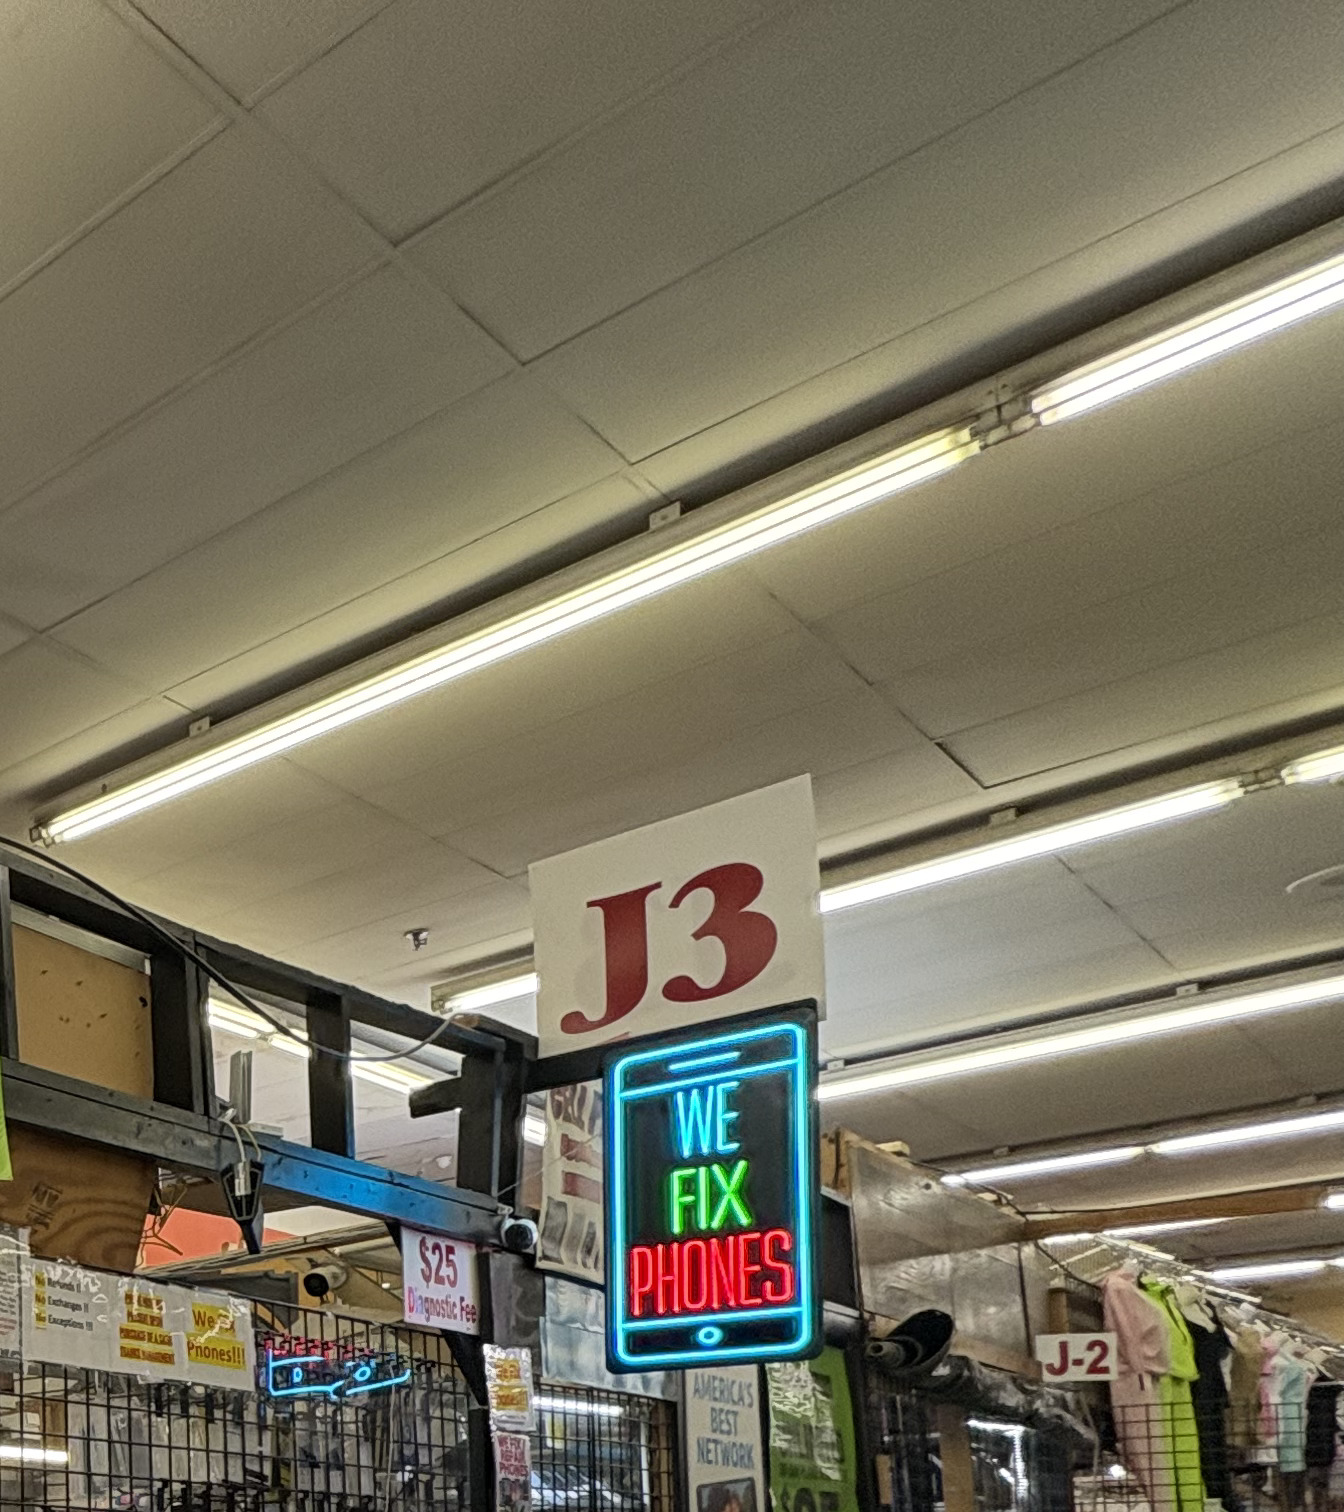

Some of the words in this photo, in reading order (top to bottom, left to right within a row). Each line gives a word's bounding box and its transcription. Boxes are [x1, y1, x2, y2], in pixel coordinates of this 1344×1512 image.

[559, 861, 779, 1036] J3
[672, 1080, 742, 1159] WE
[668, 1158, 753, 1237] FIX
[419, 1235, 459, 1290] $25
[629, 1228, 796, 1319] PHONES
[406, 1286, 458, 1324] Diagnostic
[459, 1294, 478, 1325] Fee
[1044, 1340, 1111, 1377] J-2
[692, 1371, 754, 1409] AMERICA'S
[709, 1405, 739, 1438] BEST
[695, 1436, 755, 1471] NETWORK
